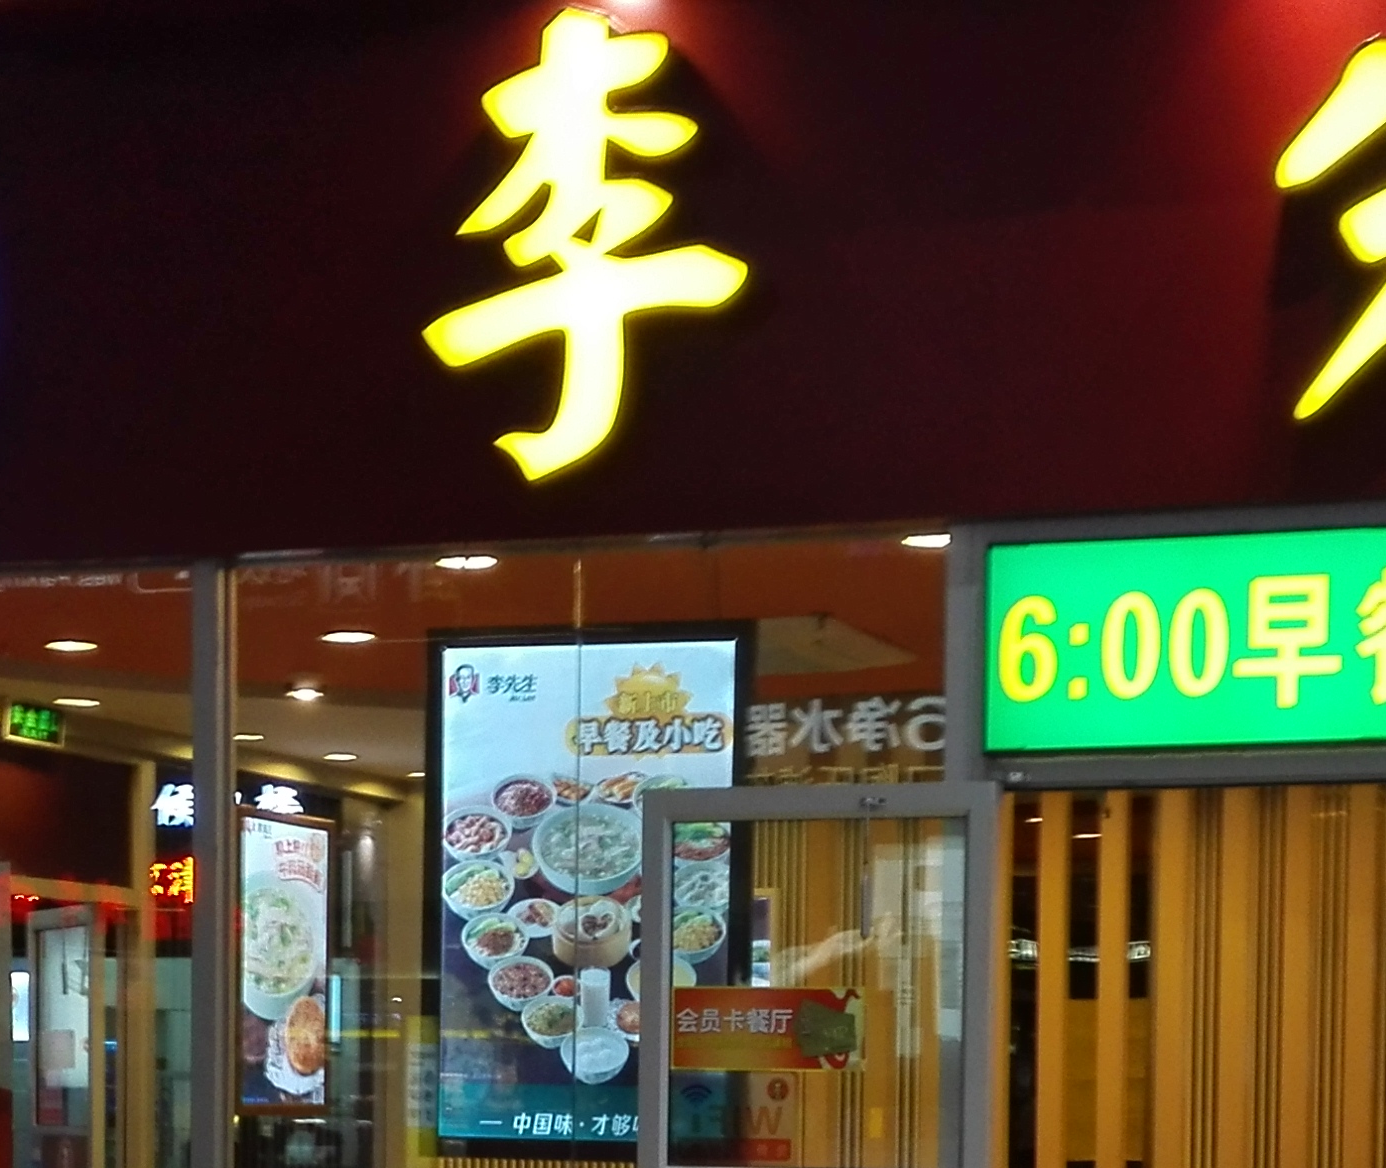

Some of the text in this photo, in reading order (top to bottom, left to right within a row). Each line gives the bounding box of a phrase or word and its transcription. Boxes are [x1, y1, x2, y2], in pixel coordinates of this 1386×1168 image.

[575, 714, 724, 755] 早餐及小吃
[676, 1008, 794, 1034] 会员卡餐厅
[513, 1112, 639, 1137] 中国味·才够
